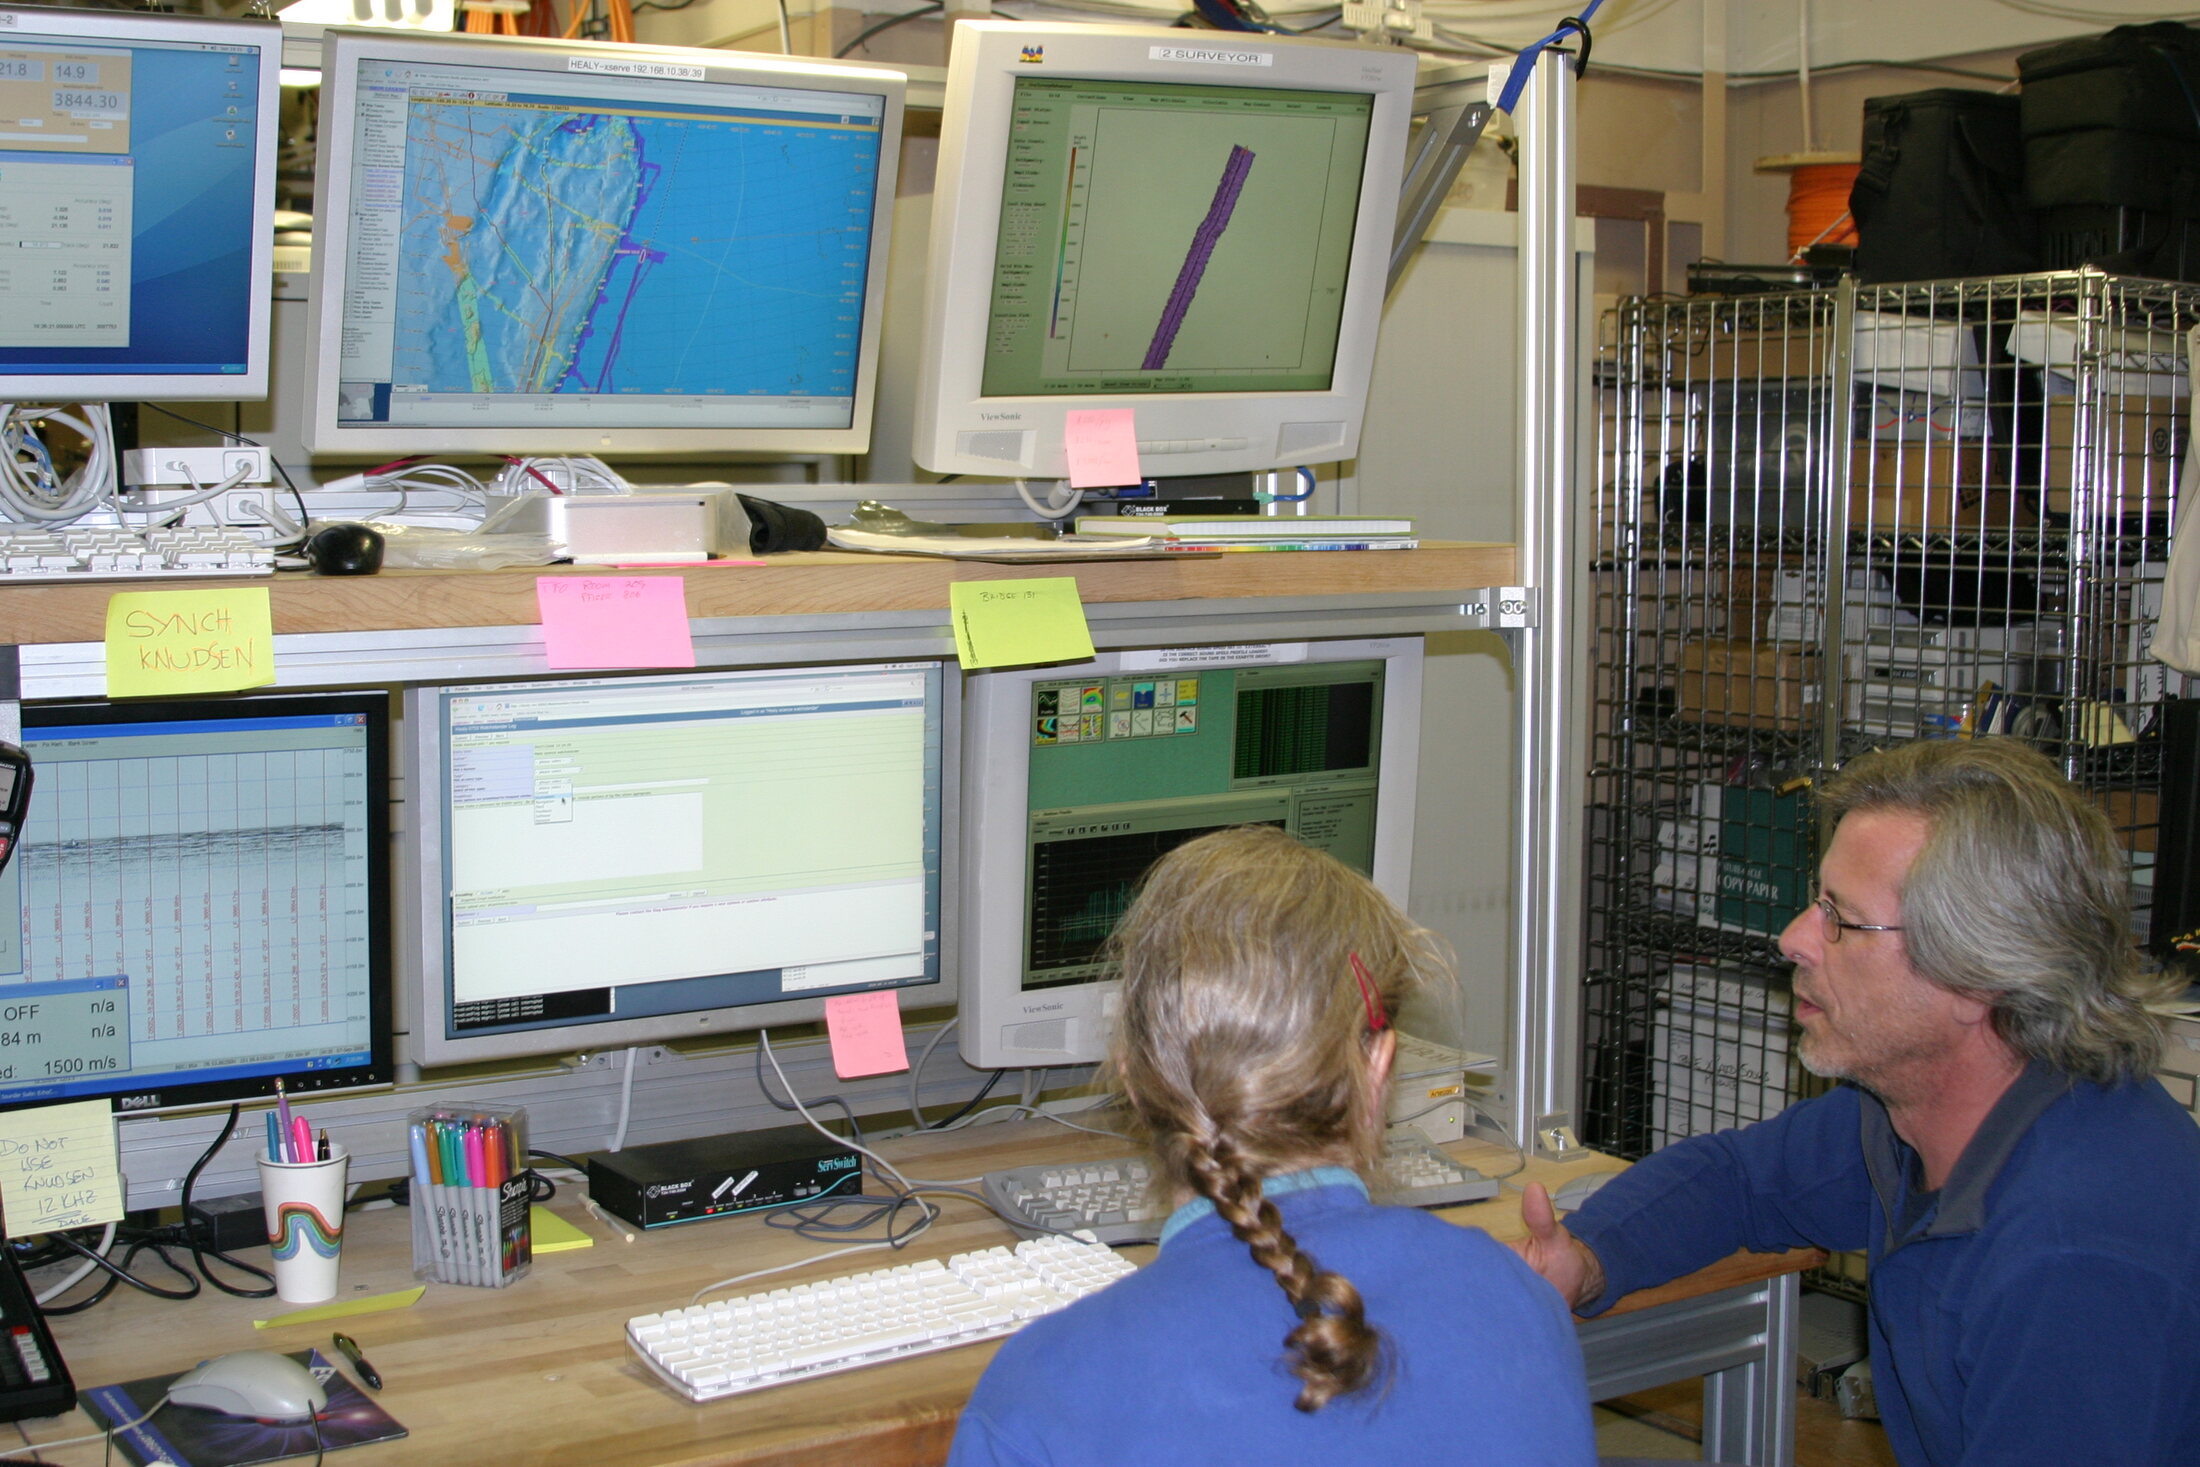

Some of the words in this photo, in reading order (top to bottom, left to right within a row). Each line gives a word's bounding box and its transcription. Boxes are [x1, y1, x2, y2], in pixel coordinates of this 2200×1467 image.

[1162, 50, 1171, 58] 2
[1175, 50, 1259, 63] SURVEYOR
[56, 65, 85, 79] 14.9
[571, 60, 630, 72] HEALY-xserve
[55, 93, 117, 108] 3844.30
[981, 413, 1022, 422] ViewSonic
[126, 609, 232, 638] SYNCH
[139, 637, 255, 674] KNUDSEN
[5, 1004, 40, 1021] OFF
[91, 998, 115, 1014] n/a
[1023, 1003, 1064, 1014] ViewSonic
[27, 1033, 41, 1044] m
[92, 1024, 116, 1038] n/a
[45, 1058, 83, 1075] 1500
[89, 1056, 117, 1070] m/s
[122, 1095, 160, 1110] DELL
[35, 1137, 69, 1152] NOT
[21, 1156, 53, 1172] USE
[817, 1155, 857, 1172] ServSwitch
[24, 1166, 95, 1192] KNUDSEN
[661, 1183, 679, 1191] BLACK
[680, 1181, 692, 1189] BOX
[38, 1197, 58, 1215] 12
